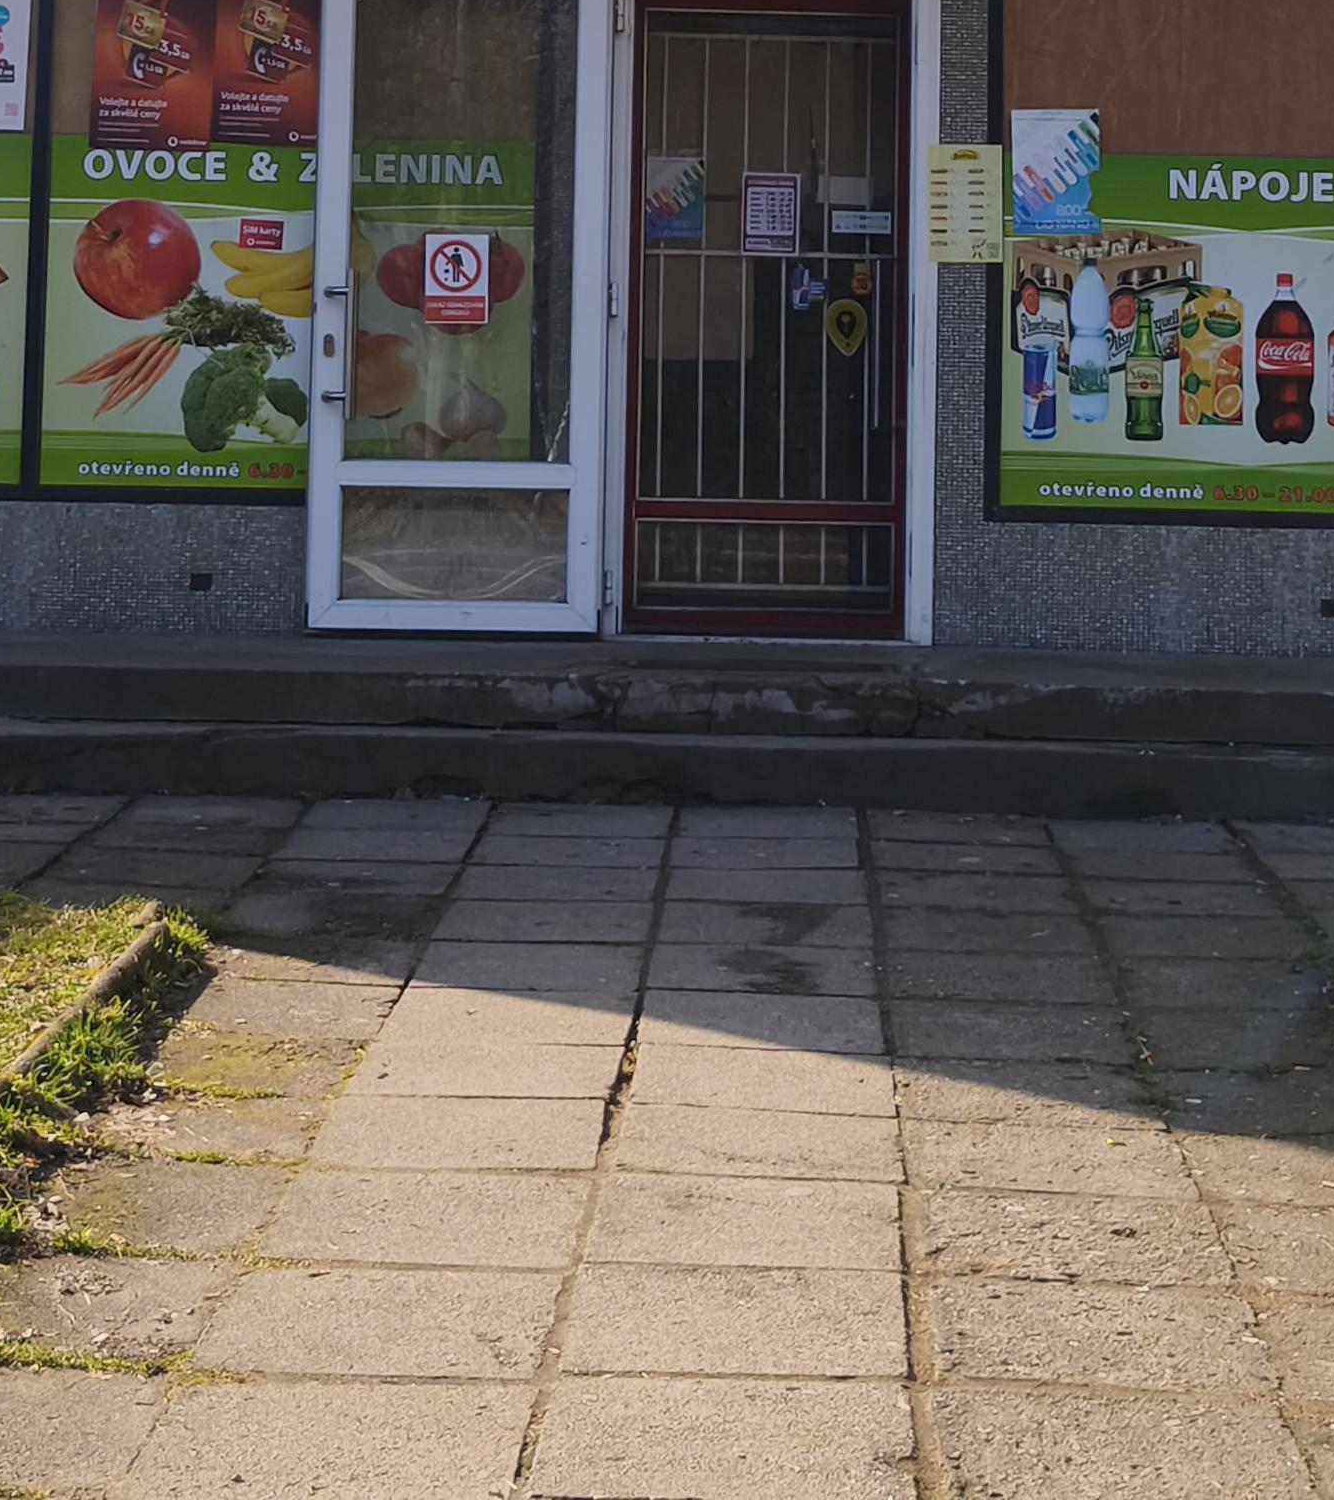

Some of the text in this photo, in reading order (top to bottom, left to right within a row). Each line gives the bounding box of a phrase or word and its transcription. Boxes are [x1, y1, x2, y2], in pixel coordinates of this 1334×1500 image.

[83, 150, 504, 186] OVOCE & ZLENINA
[1168, 163, 1334, 203] NÁPOJE
[78, 459, 171, 477] otevřeno
[175, 460, 241, 478] denně
[247, 462, 295, 479] 6.30
[1038, 480, 1134, 498] otevřeno
[1138, 481, 1205, 500] denně
[1213, 485, 1260, 502] 6.30
